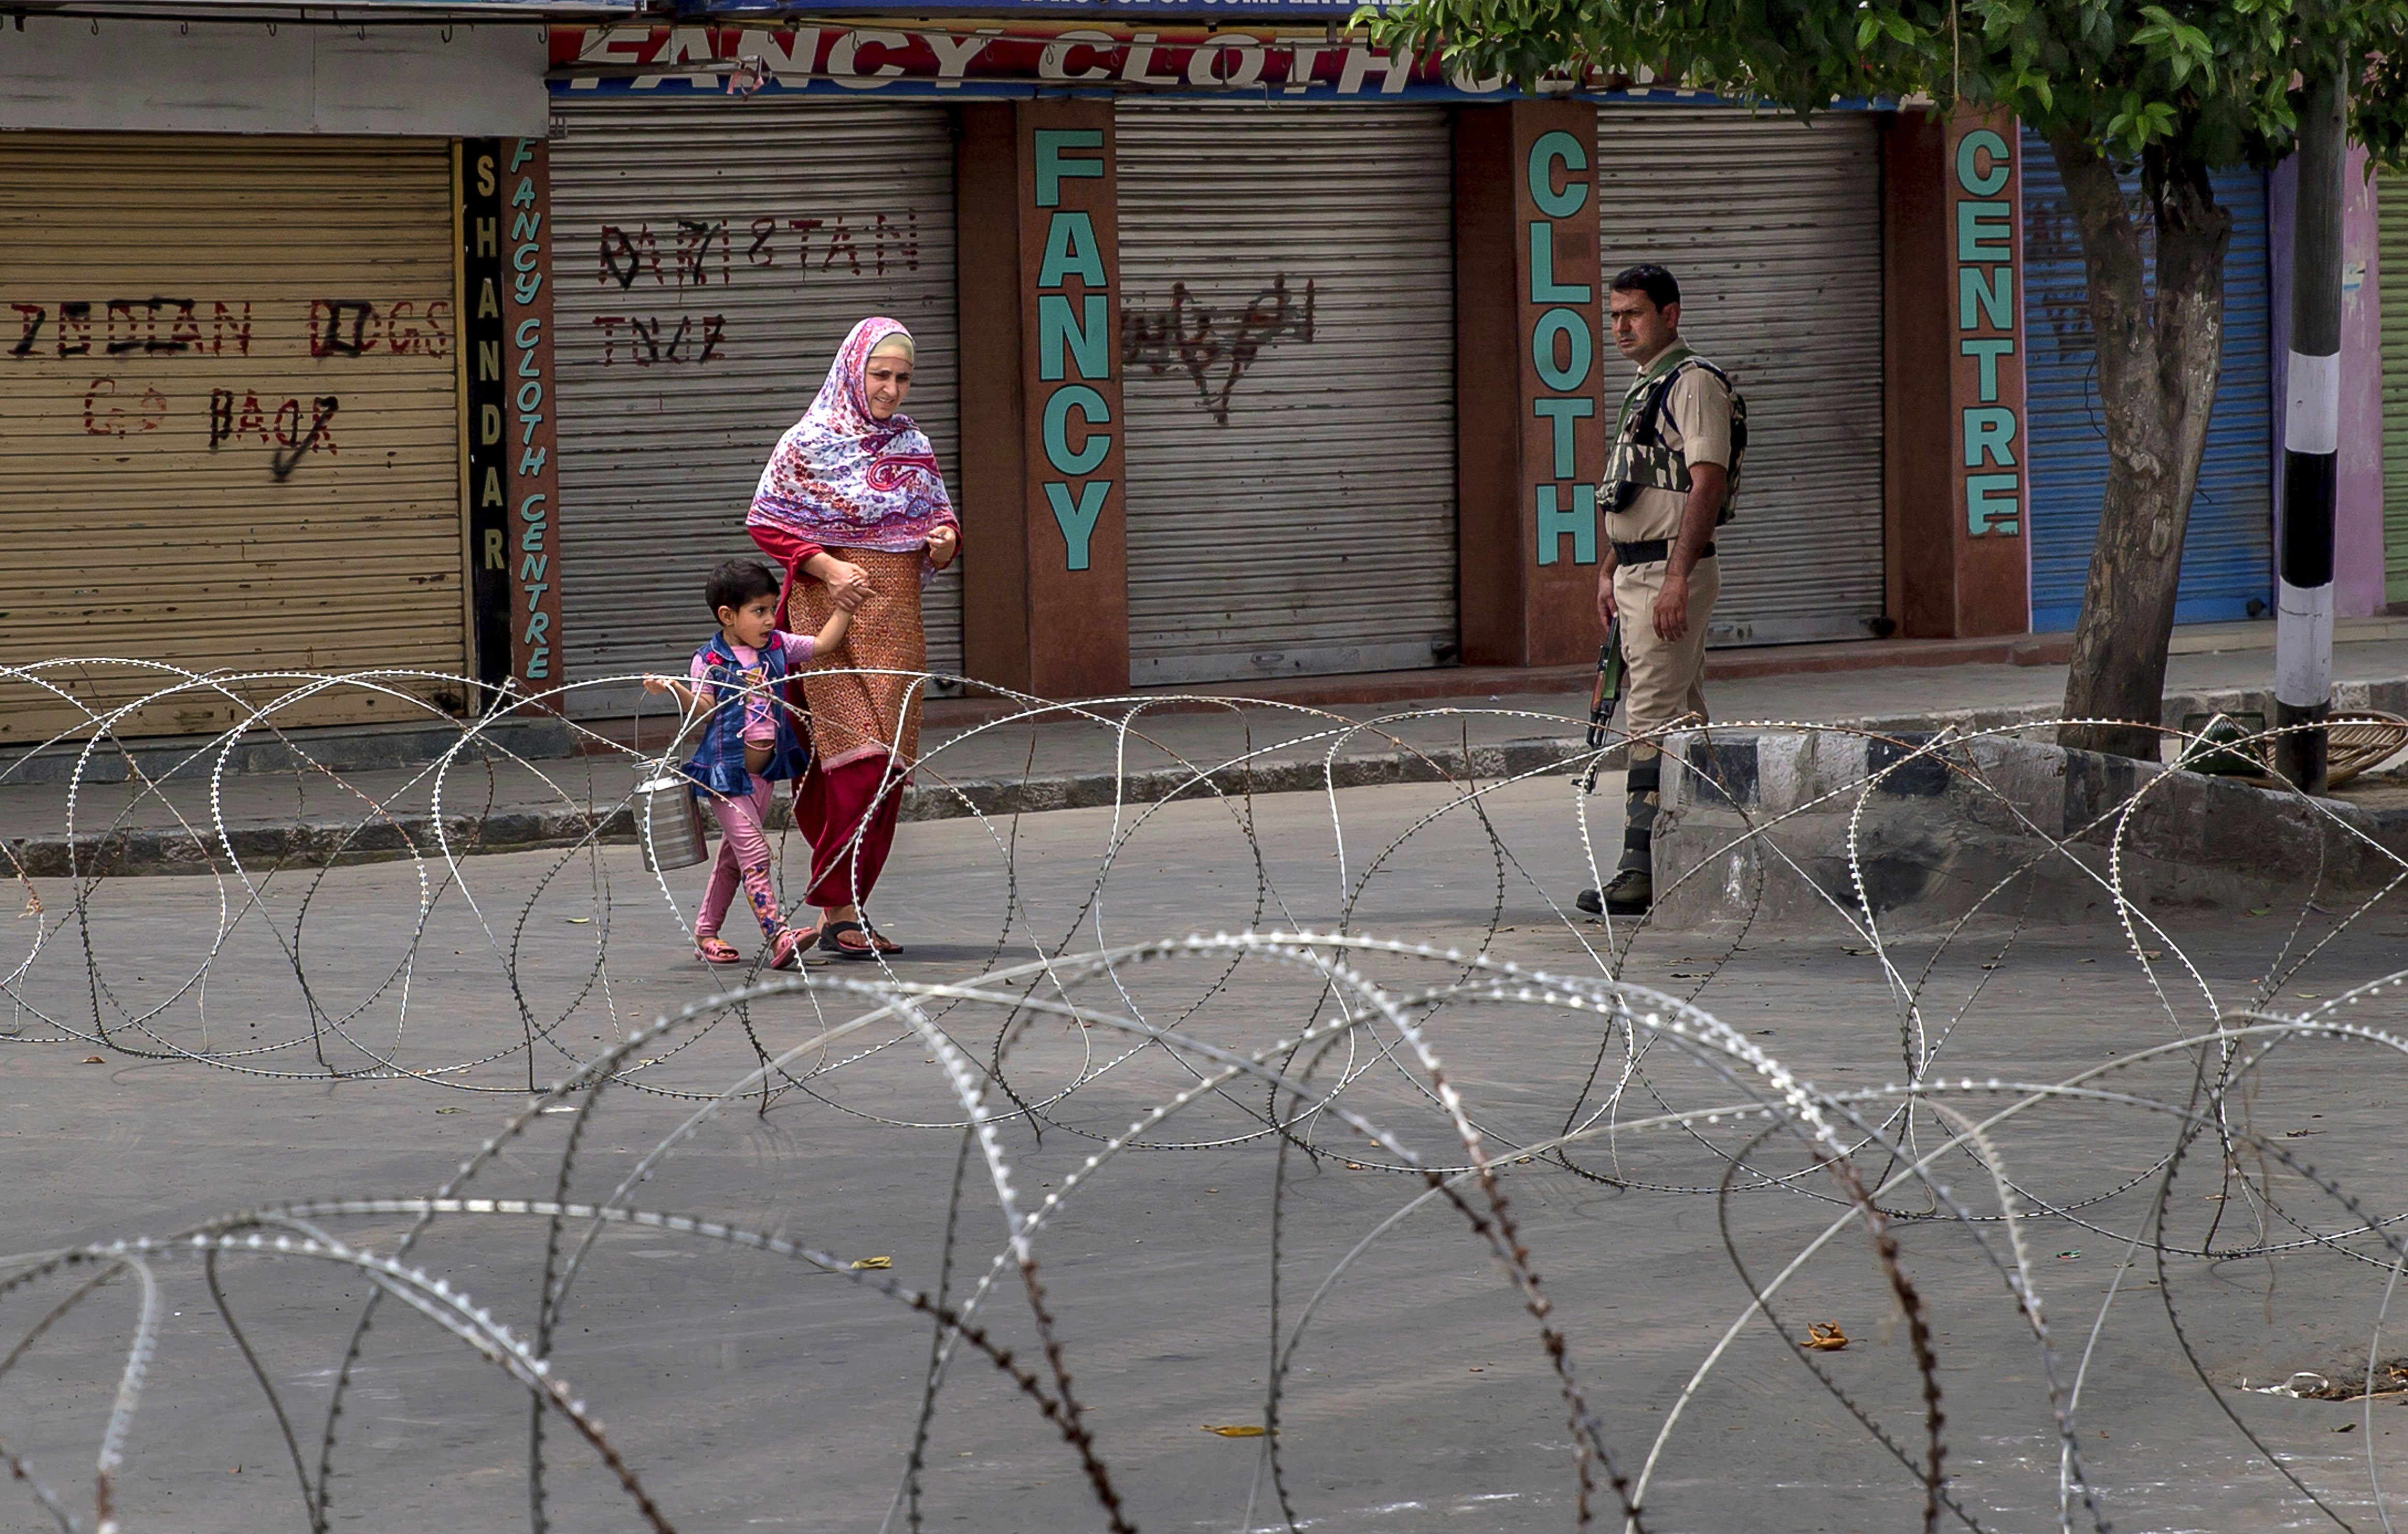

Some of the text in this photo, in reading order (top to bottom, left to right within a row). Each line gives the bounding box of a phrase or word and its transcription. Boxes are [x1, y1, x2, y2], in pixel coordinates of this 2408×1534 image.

[570, 27, 1005, 89] FANCY
[1038, 30, 1415, 94] CLOTH
[476, 155, 505, 569] SHANDAR
[510, 137, 549, 678] FANCY CLOTH CENTRE
[1034, 128, 1113, 571] FANCY
[1527, 130, 1598, 566] CLOTH
[1955, 128, 2020, 538] CENTRE
